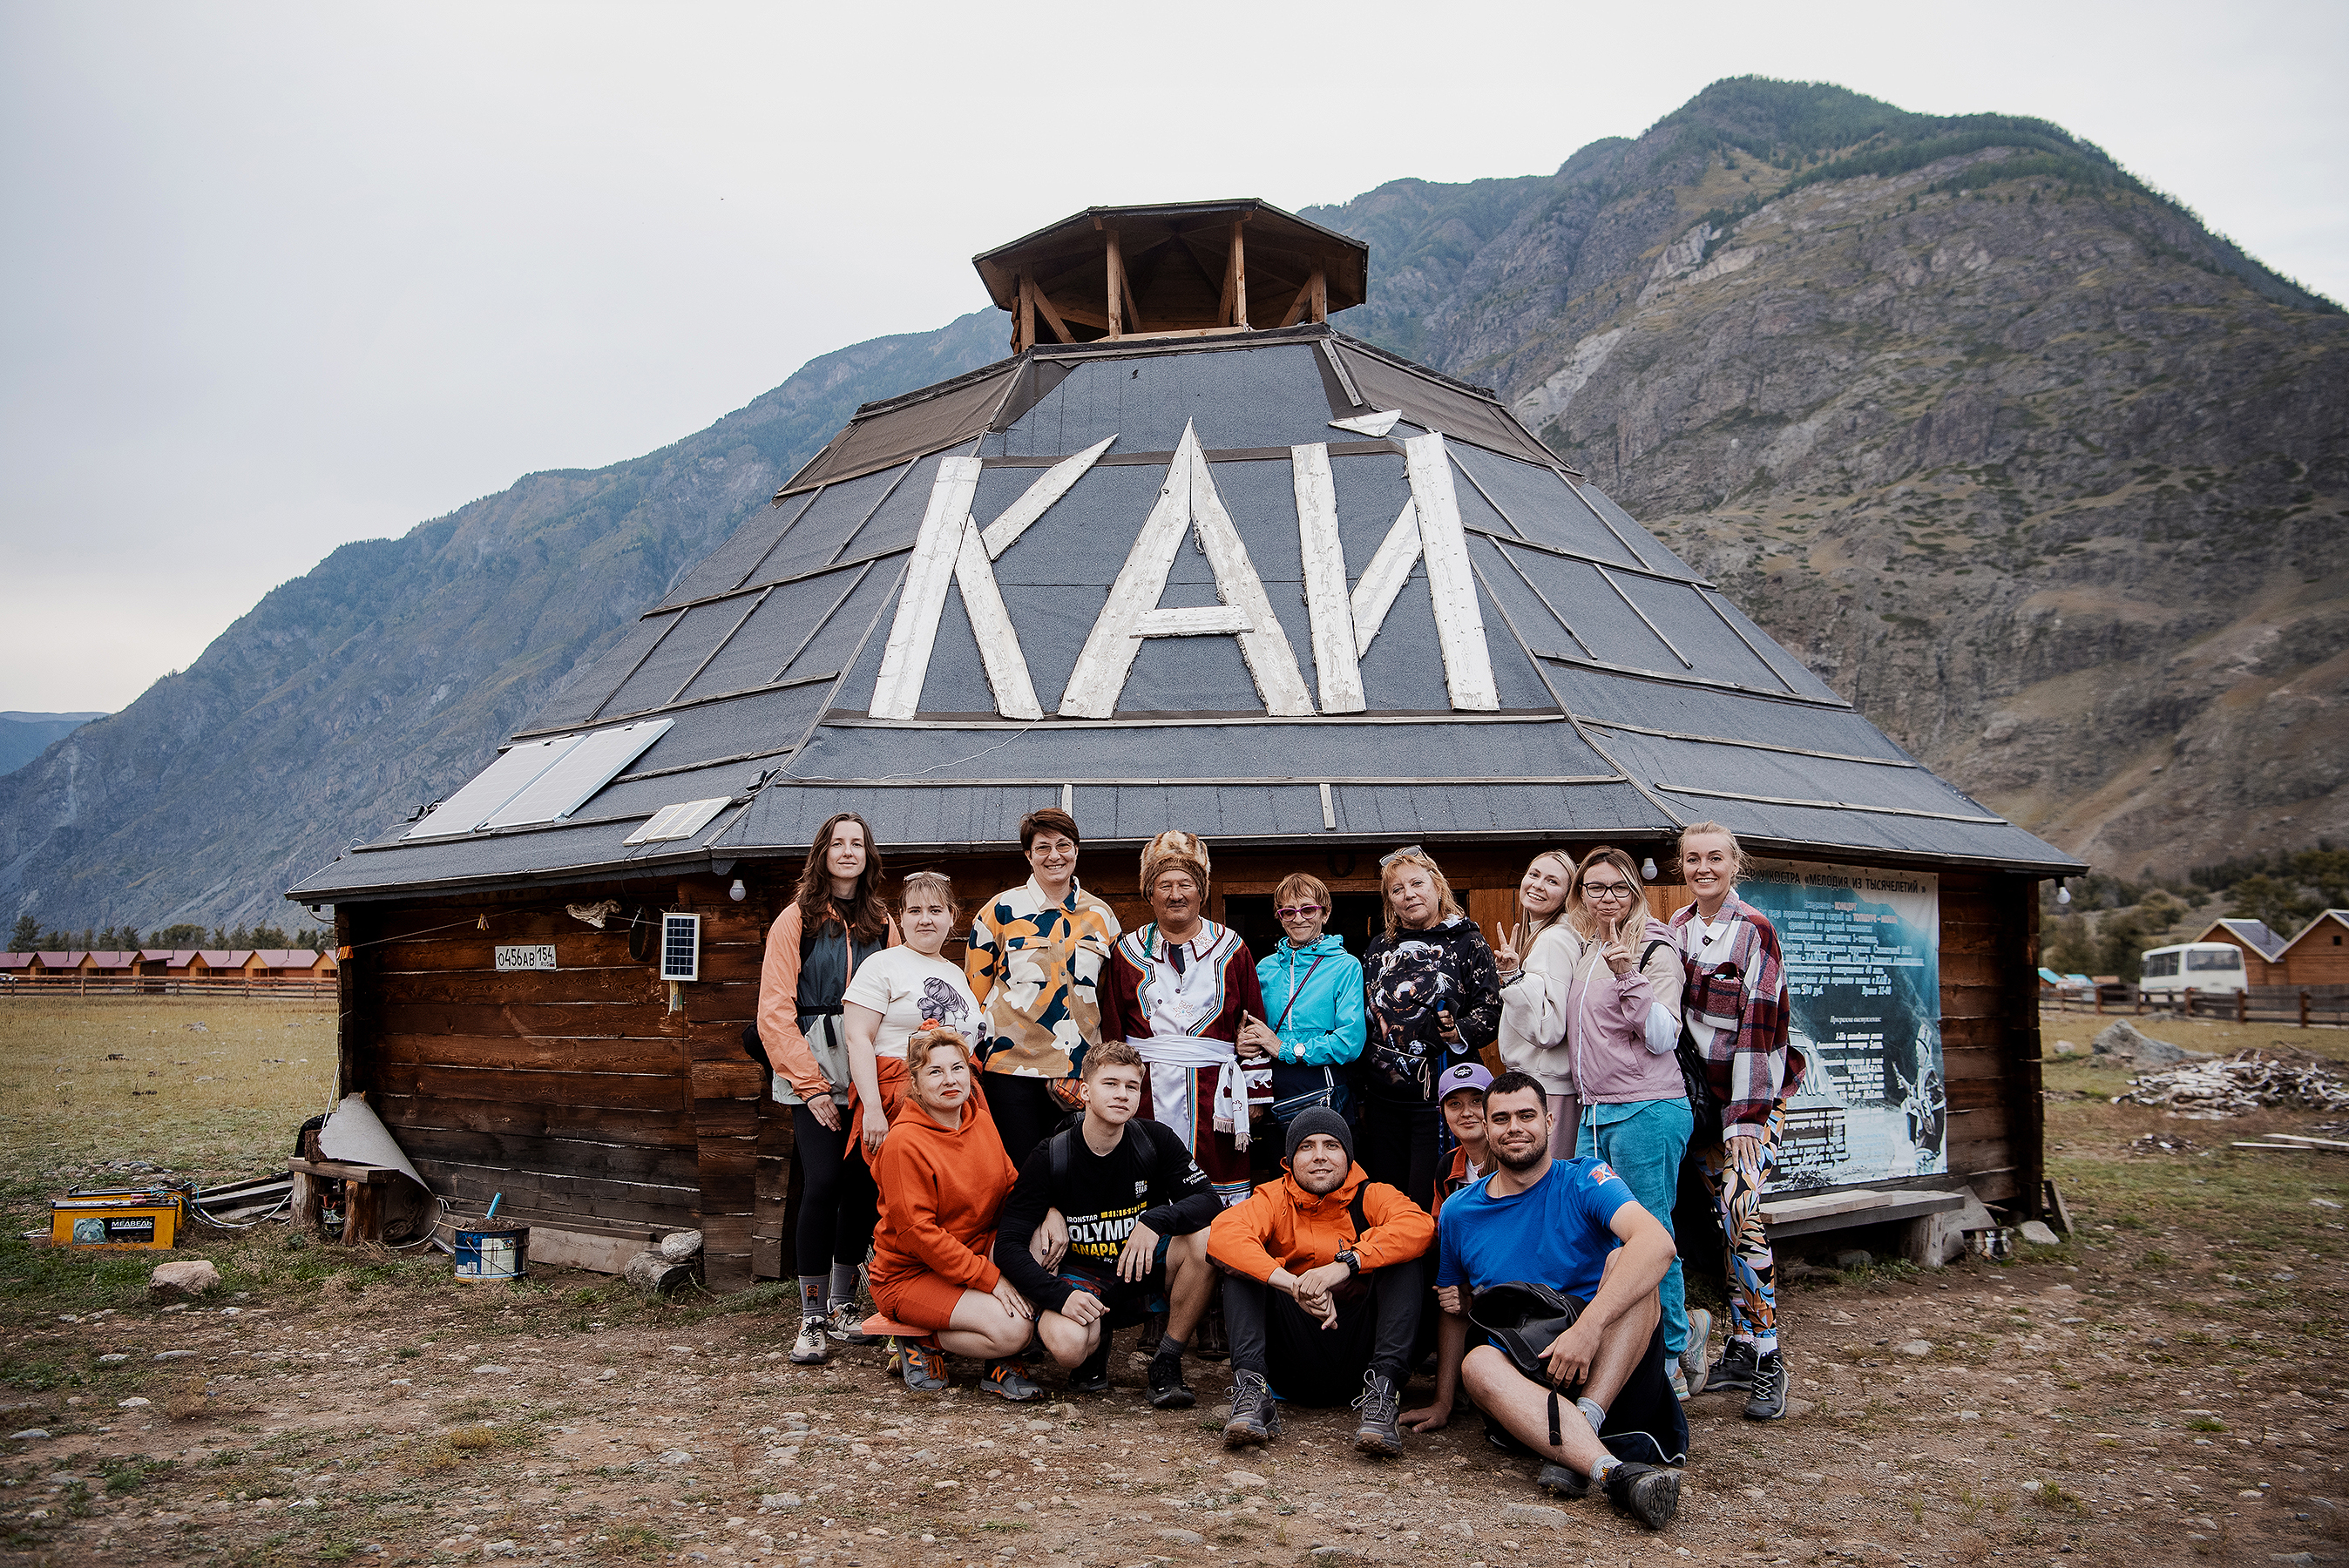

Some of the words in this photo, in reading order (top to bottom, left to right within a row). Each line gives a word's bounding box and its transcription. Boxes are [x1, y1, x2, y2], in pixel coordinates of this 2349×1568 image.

[869, 409, 1500, 720] КАЙ
[1759, 869, 1765, 882] У
[1769, 870, 1801, 885] КОСТРА
[1804, 874, 1849, 890] «МЕЛОДИЯ
[1852, 878, 1862, 889] ИЗ
[1865, 879, 1918, 894] ТЫСЯЧЕЛЕТИЙ
[536, 946, 553, 962] 154
[1066, 1214, 1098, 1223] IRONSTAR
[1072, 1242, 1119, 1256] ANAPA
